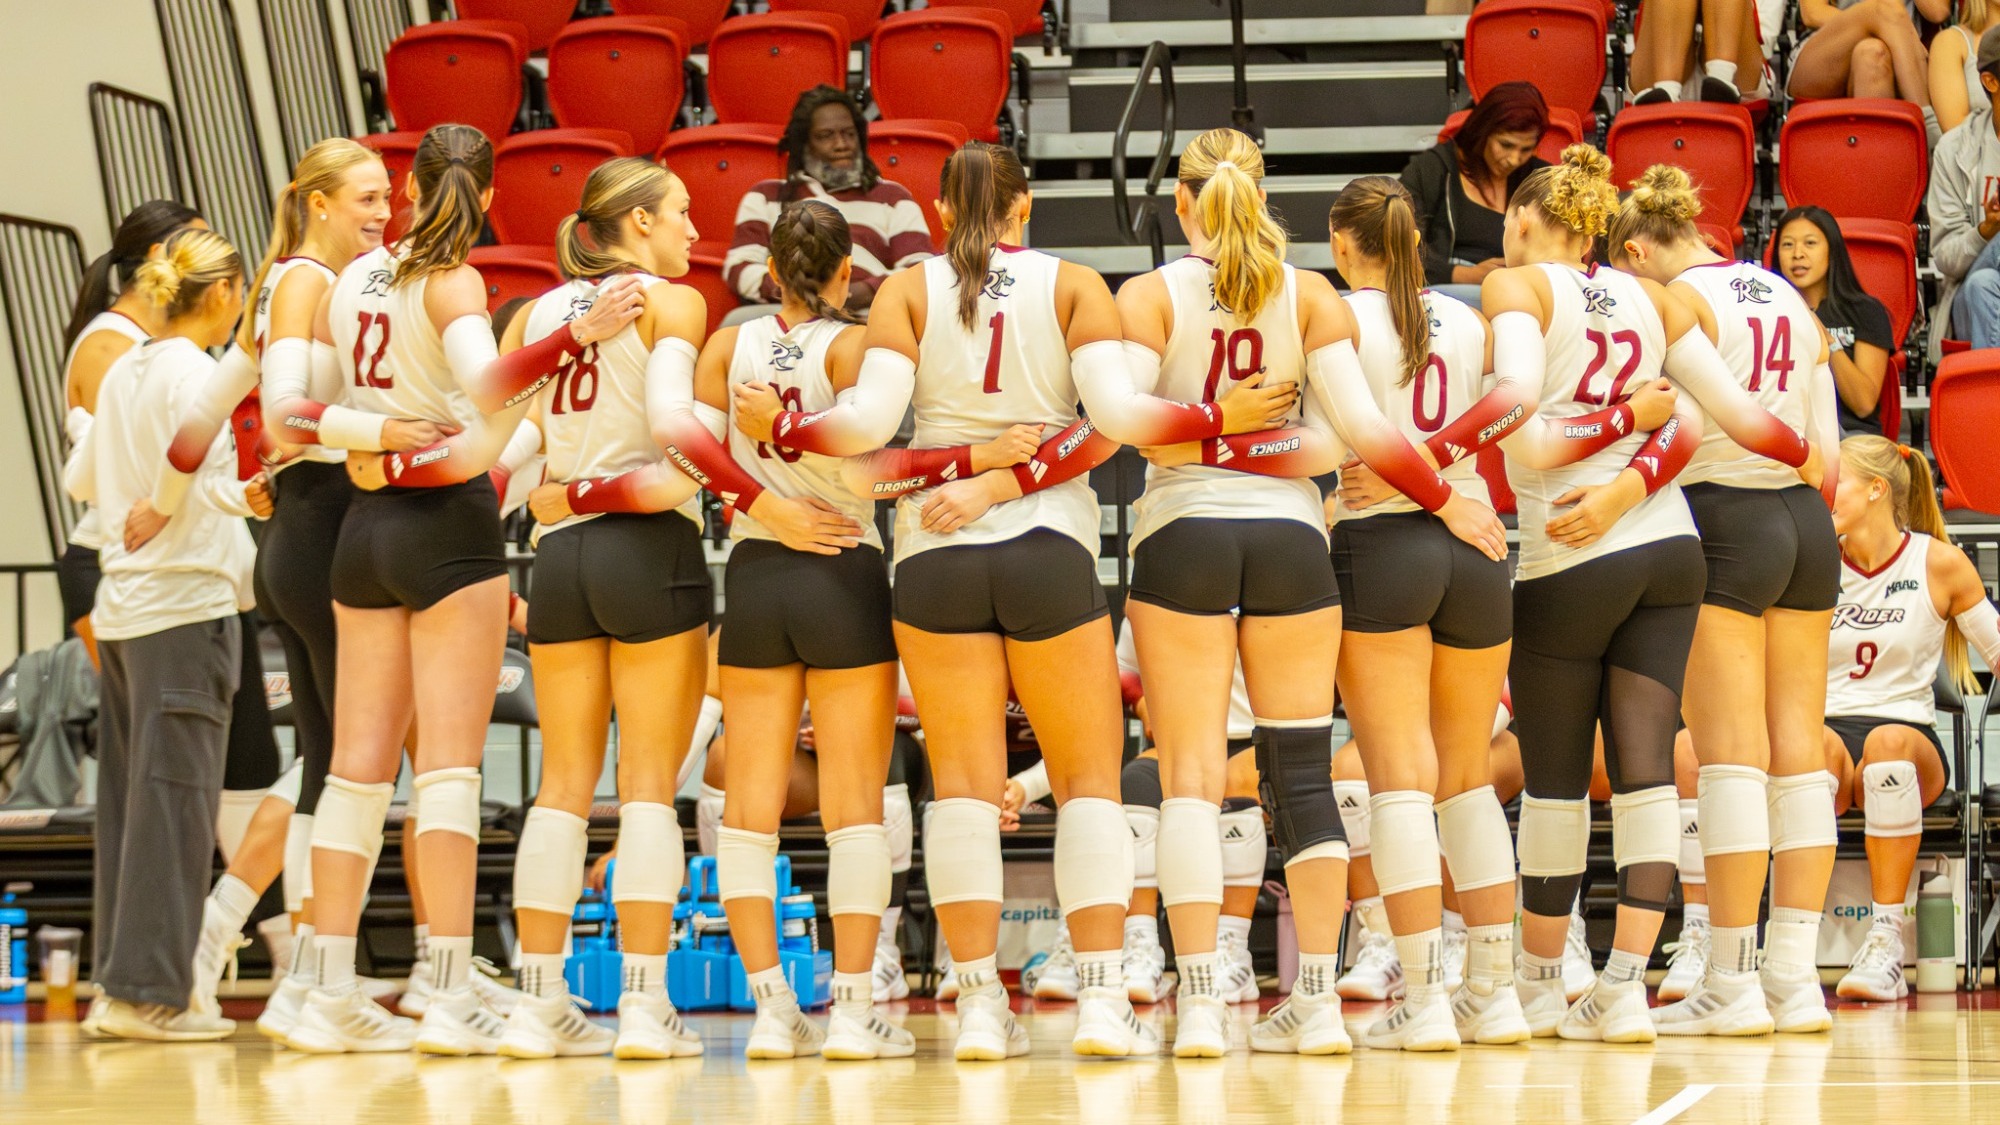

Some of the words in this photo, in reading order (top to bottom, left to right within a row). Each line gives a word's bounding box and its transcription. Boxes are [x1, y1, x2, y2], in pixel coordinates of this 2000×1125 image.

[354, 311, 394, 389] 12
[983, 312, 1004, 394] 1
[1572, 328, 1642, 406] 22
[1747, 316, 1795, 392] 14
[552, 341, 599, 414] 18
[1478, 404, 1524, 444] BRONCS
[1564, 423, 1602, 439] BRONCS
[411, 446, 450, 468] BRONCS
[664, 444, 712, 485] BRONCS
[1248, 437, 1300, 458] BRONCS
[872, 475, 928, 493] BRONCS
[1884, 580, 1919, 599] MAAC
[1830, 603, 1905, 630] RIDER
[1849, 641, 1878, 679] 9
